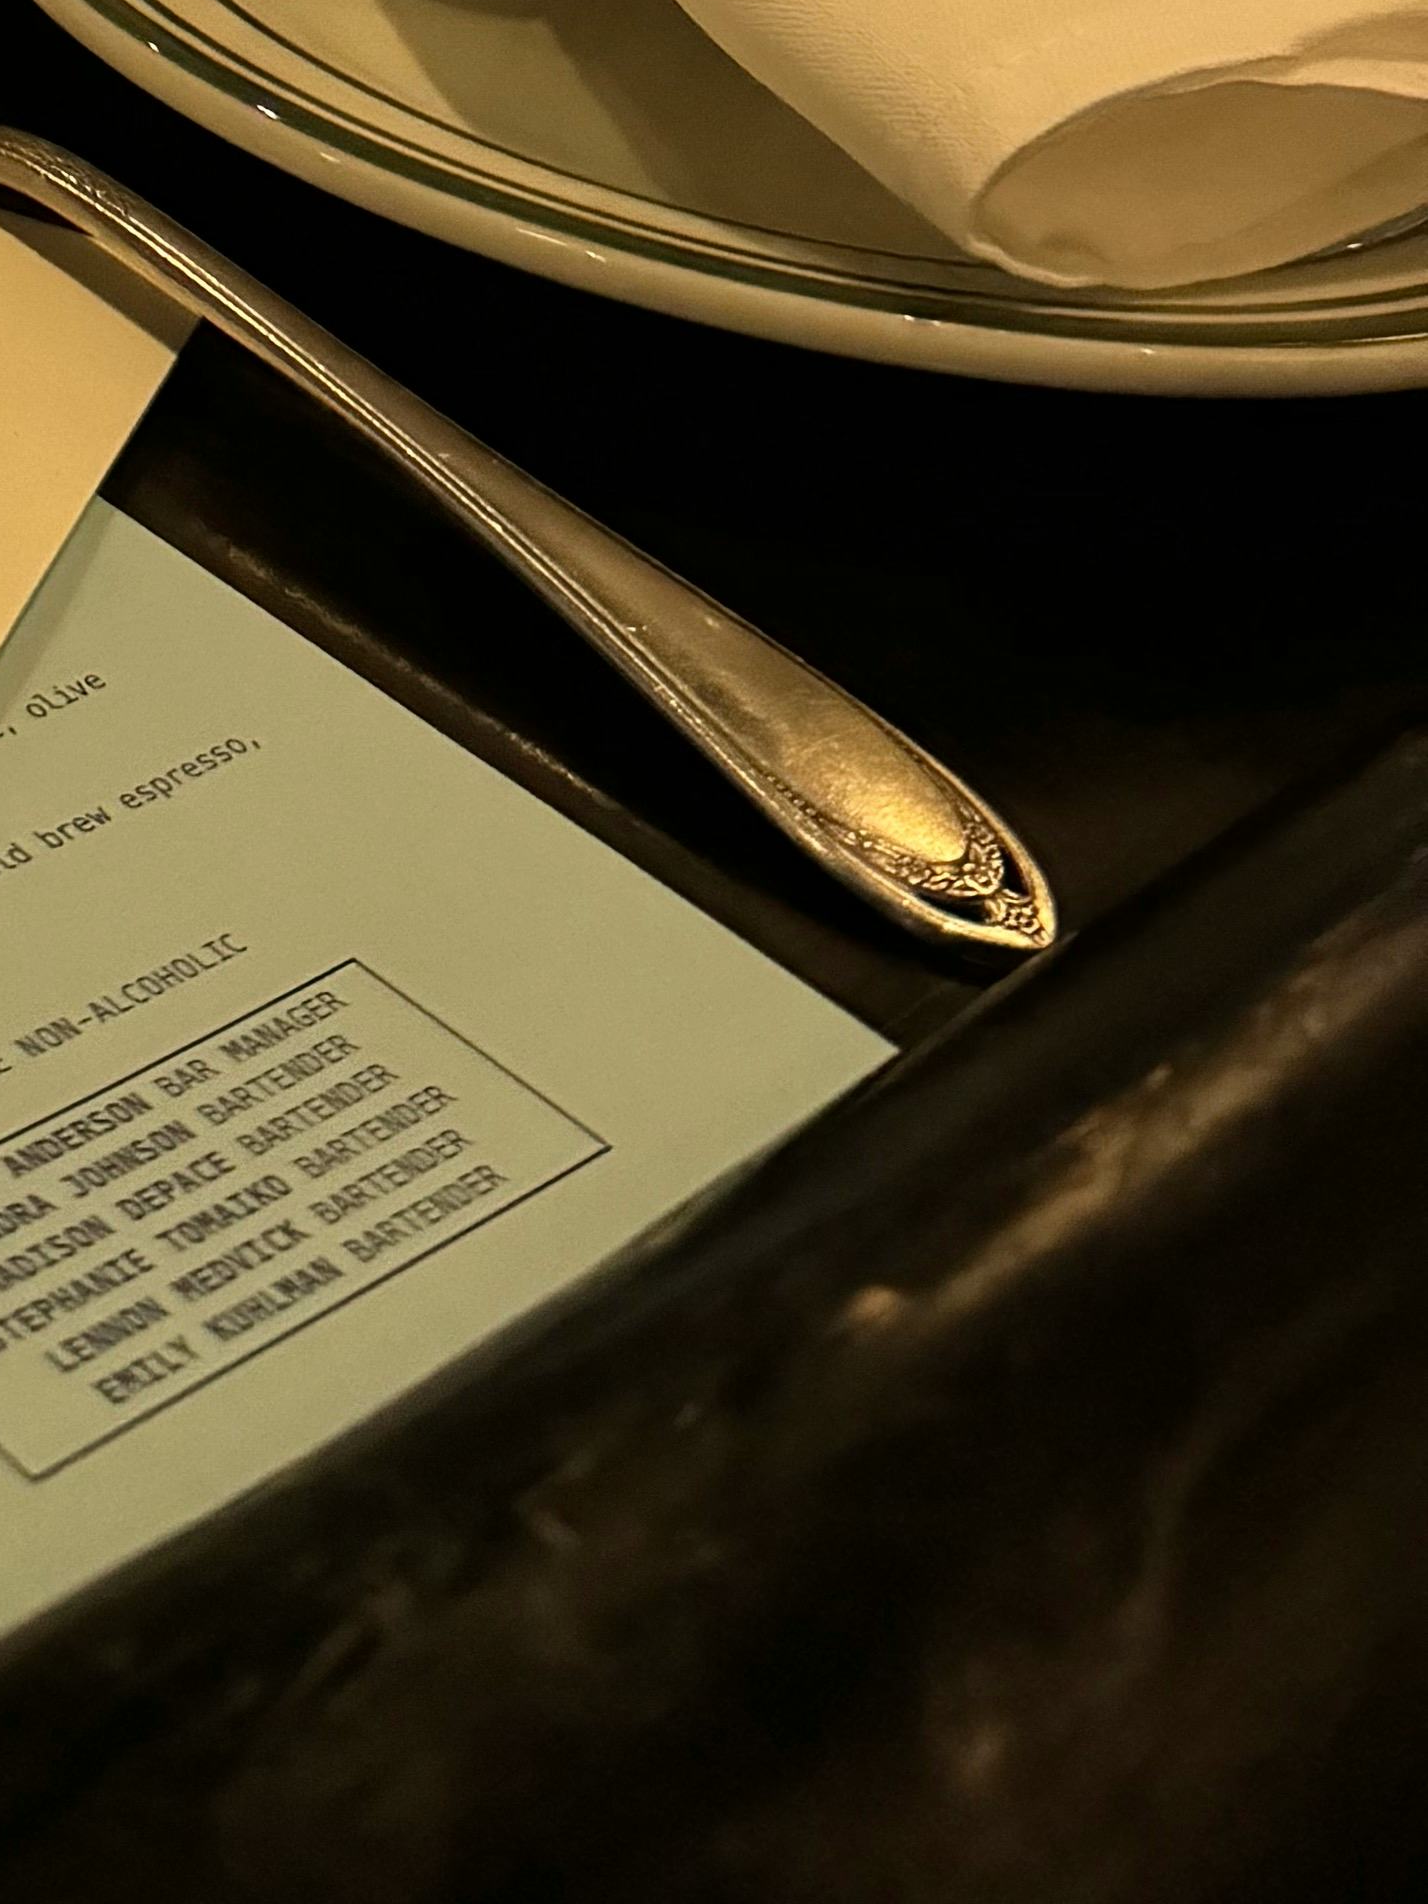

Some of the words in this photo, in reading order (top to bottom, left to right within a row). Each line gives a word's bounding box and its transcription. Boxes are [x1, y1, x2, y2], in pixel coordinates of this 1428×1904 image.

[26, 674, 107, 718] olive
[33, 806, 112, 849] brew
[119, 739, 261, 809] espresso,
[14, 933, 248, 1057] NON-ALCOHOLIC
[0, 1092, 154, 1179] ANDERSON
[152, 1059, 221, 1098] BAR
[218, 991, 350, 1063] MANAGER
[59, 1120, 198, 1199] JOHNSON
[196, 1035, 361, 1126] BARTENDER
[114, 1151, 236, 1221] DEPACE
[235, 1064, 400, 1157] BARTENDER
[153, 1175, 293, 1252] TOMAIKO
[291, 1086, 458, 1179] BARTENDER
[45, 1297, 171, 1374] LENNON
[308, 1129, 473, 1225] BARTENDER
[91, 1335, 199, 1405] EMILY
[202, 1256, 345, 1342] KUHLMAN
[341, 1165, 509, 1263] BARTENDER
